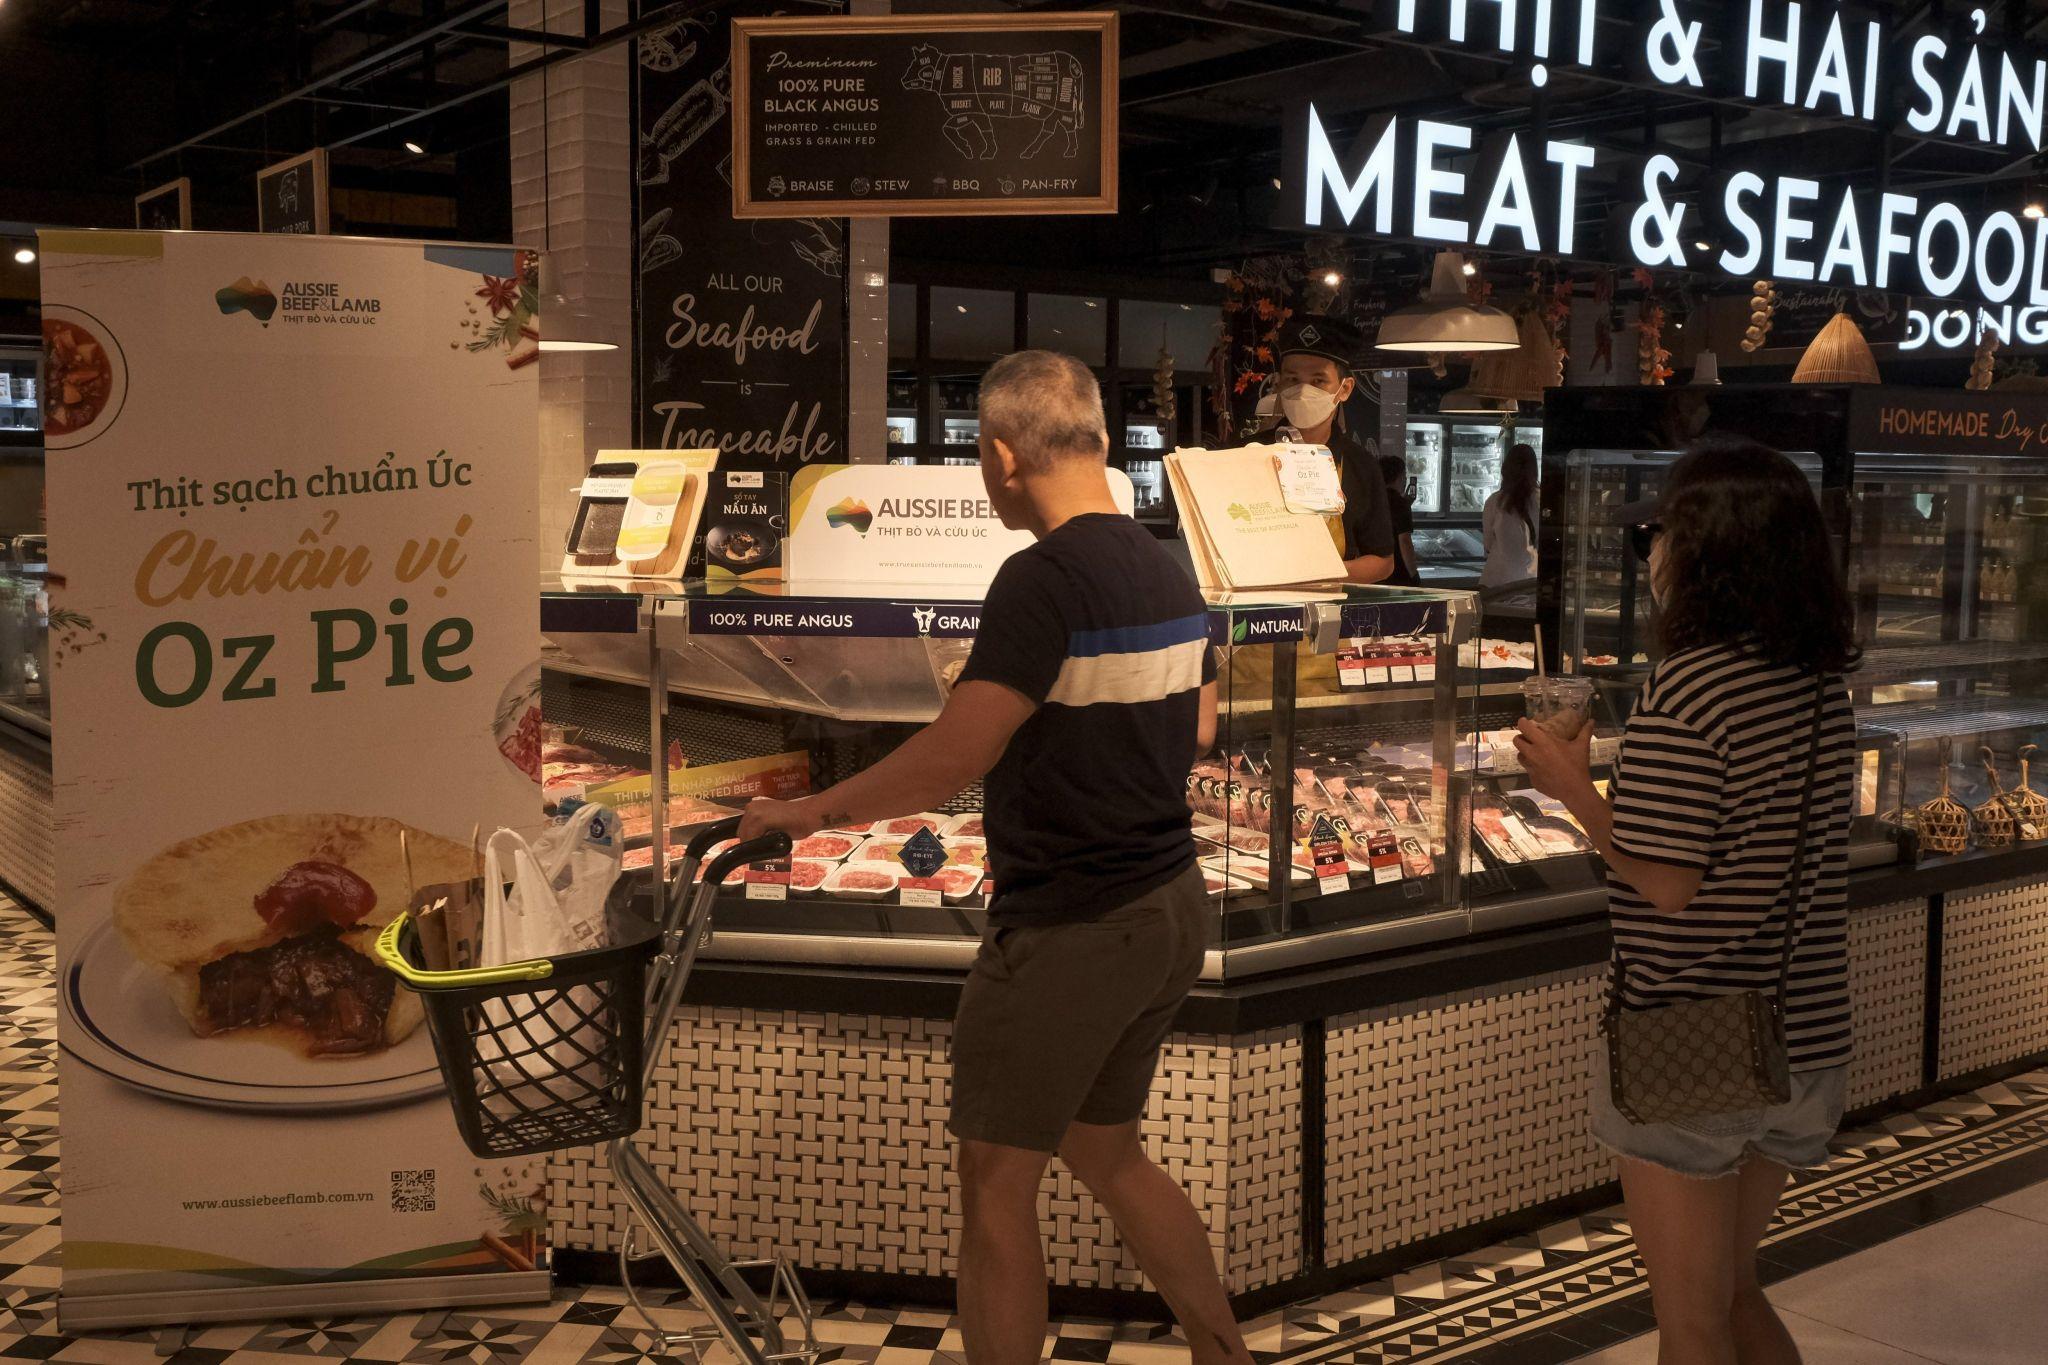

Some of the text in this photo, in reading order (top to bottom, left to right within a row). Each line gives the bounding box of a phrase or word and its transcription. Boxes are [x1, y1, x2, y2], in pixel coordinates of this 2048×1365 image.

[983, 67, 1002, 86] RIB
[1647, 0, 1703, 87] &
[1907, 8, 2047, 152] SẢN
[779, 78, 865, 92] 100% PURE
[764, 98, 879, 112] BLACK ANGUS
[989, 100, 1005, 110] PLATE
[1021, 102, 1041, 115] FLANK
[765, 123, 818, 132] IMPORTED
[833, 122, 877, 132] CHILLED
[766, 136, 876, 146] GRASS & GRAIN FED
[790, 180, 834, 192] BRAISE
[874, 179, 910, 191] STEW
[952, 179, 980, 191] BBQ
[1022, 178, 1077, 190] PAN-FRY
[1305, 101, 1595, 254] MEAT
[1630, 154, 1687, 266] &
[282, 282, 339, 297] AUSSIE
[707, 273, 783, 293] ALL OUR
[282, 296, 381, 313] BEEF&LAMB
[1773, 288, 1848, 312] Sustainably
[282, 315, 303, 325] THỊT
[324, 314, 336, 324] VÀ
[362, 315, 376, 325] ÚC
[665, 293, 823, 365] Seafood
[740, 378, 752, 395] is
[652, 400, 836, 463] Traceable
[1879, 407, 1990, 437] HOMEMADE
[1995, 407, 2035, 450] Dry
[127, 449, 472, 517] Thịt sạch chuẩn Úc
[723, 500, 767, 515] NẤU ĂN
[877, 498, 956, 519] AUSSIE
[877, 526, 902, 538] THỊT
[906, 525, 922, 537] BÒ
[926, 525, 941, 537] VÀ
[972, 525, 988, 538] ÚC
[134, 509, 473, 608] Chuẩn vị
[709, 613, 853, 628] 100% PURE ANGUS
[1250, 619, 1304, 635] NATURAL
[135, 598, 474, 708] Oz Pie
[679, 781, 761, 801] PORTED BEEF
[1378, 847, 1387, 855] 5%
[1325, 857, 1334, 865] 5%
[182, 1191, 374, 1211] www.aussiebeeflamb.com.vn
